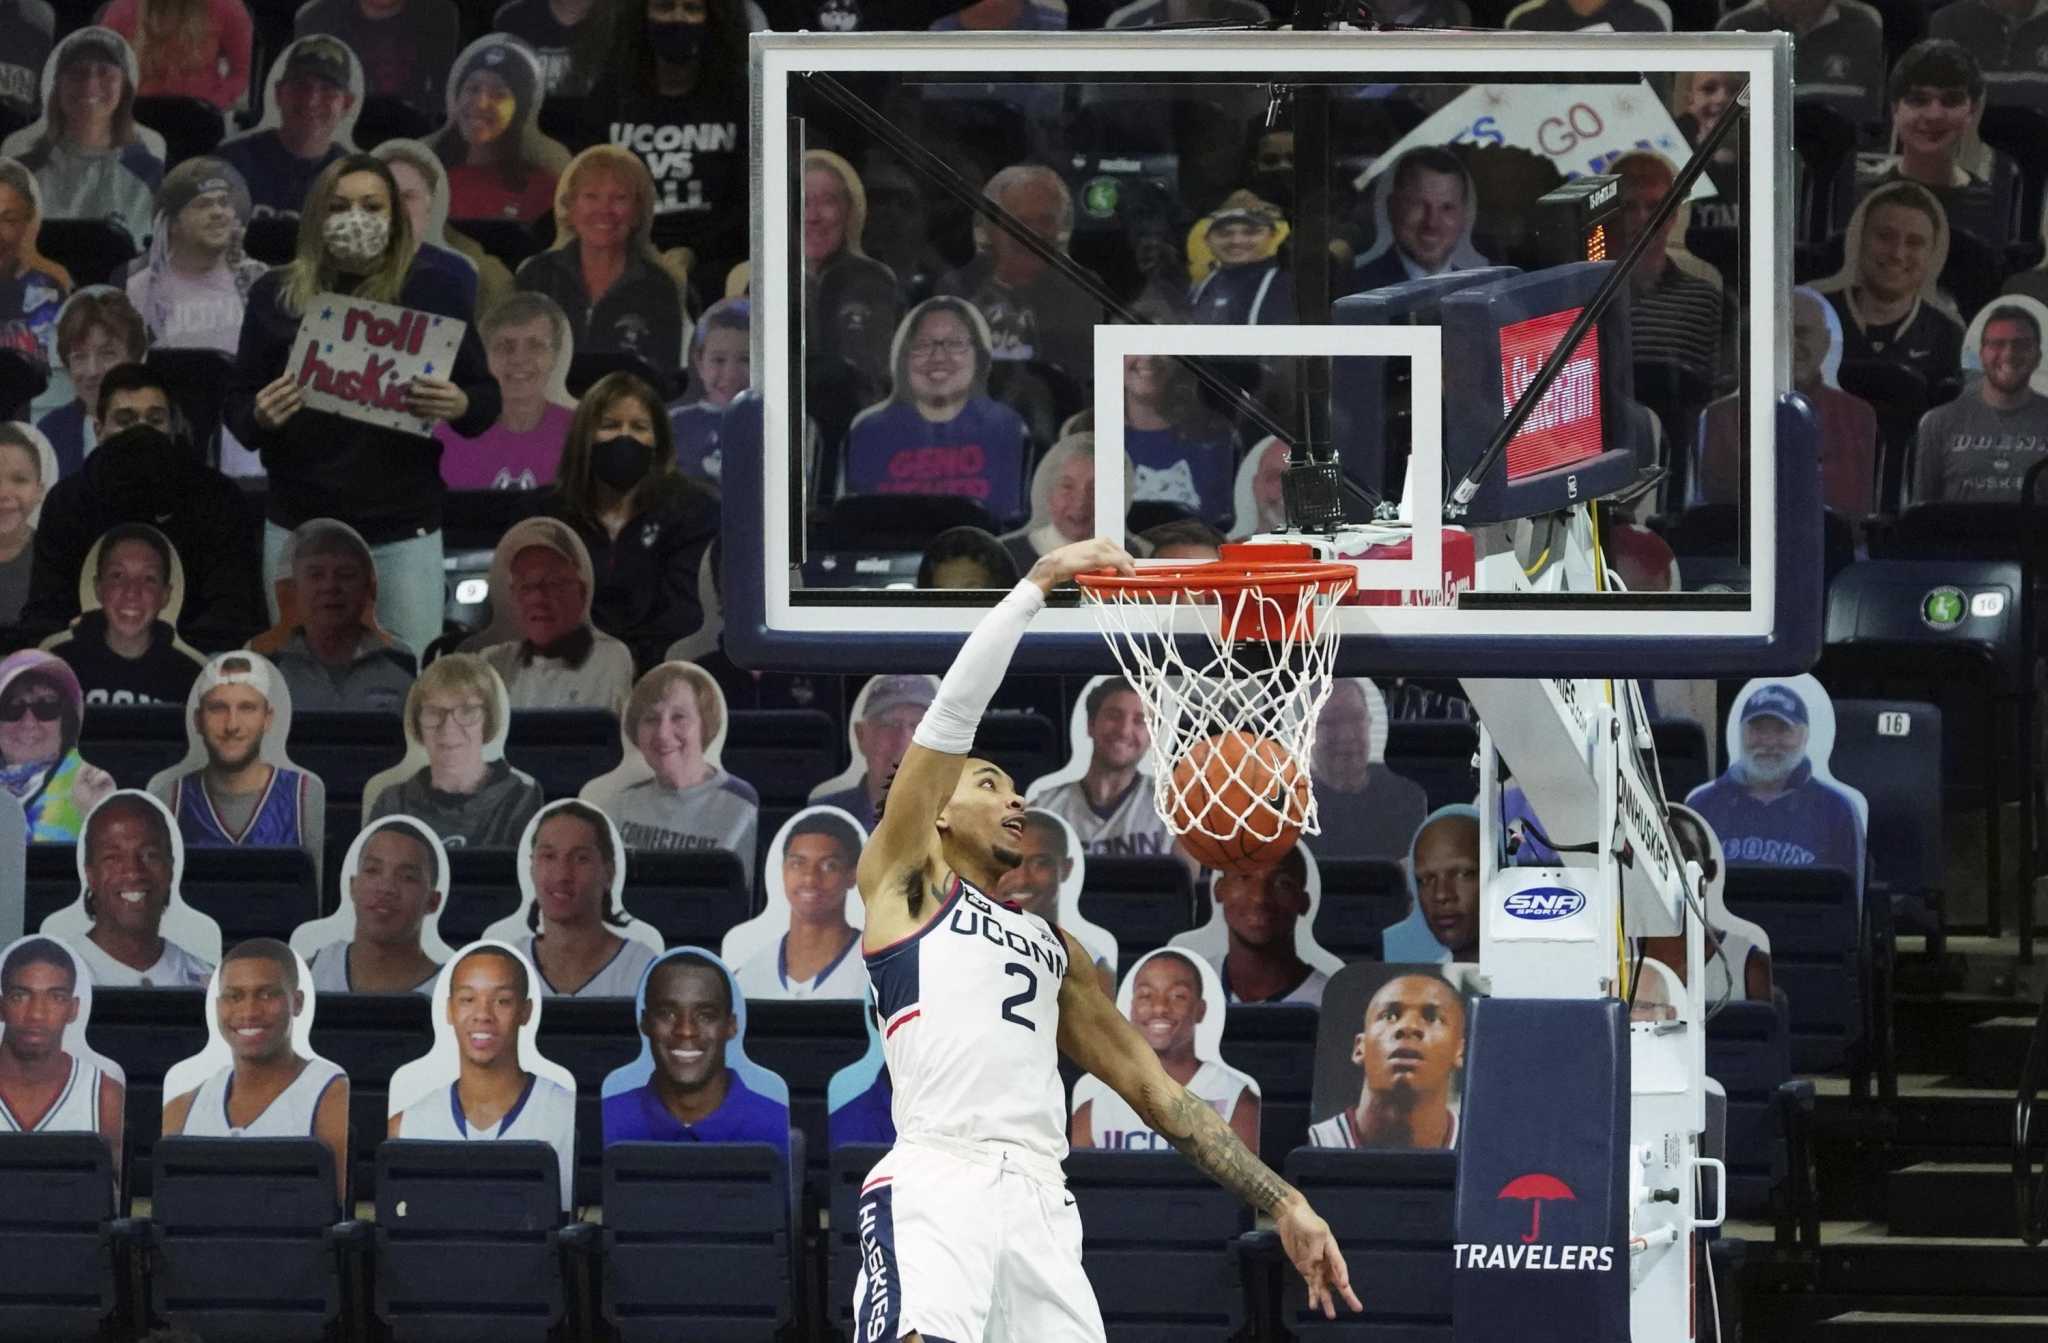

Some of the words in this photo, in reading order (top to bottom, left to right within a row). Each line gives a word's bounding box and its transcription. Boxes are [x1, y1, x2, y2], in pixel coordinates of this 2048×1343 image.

[609, 122, 737, 152] UCONN
[1537, 102, 1604, 156] GO
[645, 151, 693, 179] VS
[342, 307, 430, 355] roll
[1979, 598, 1998, 611] 16
[1886, 714, 1904, 733] 16
[950, 909, 1068, 979] UCONN
[1002, 963, 1038, 1032] 2
[859, 1202, 889, 1343] HUSKIES
[1453, 1244, 1615, 1271] TRAVELERS
